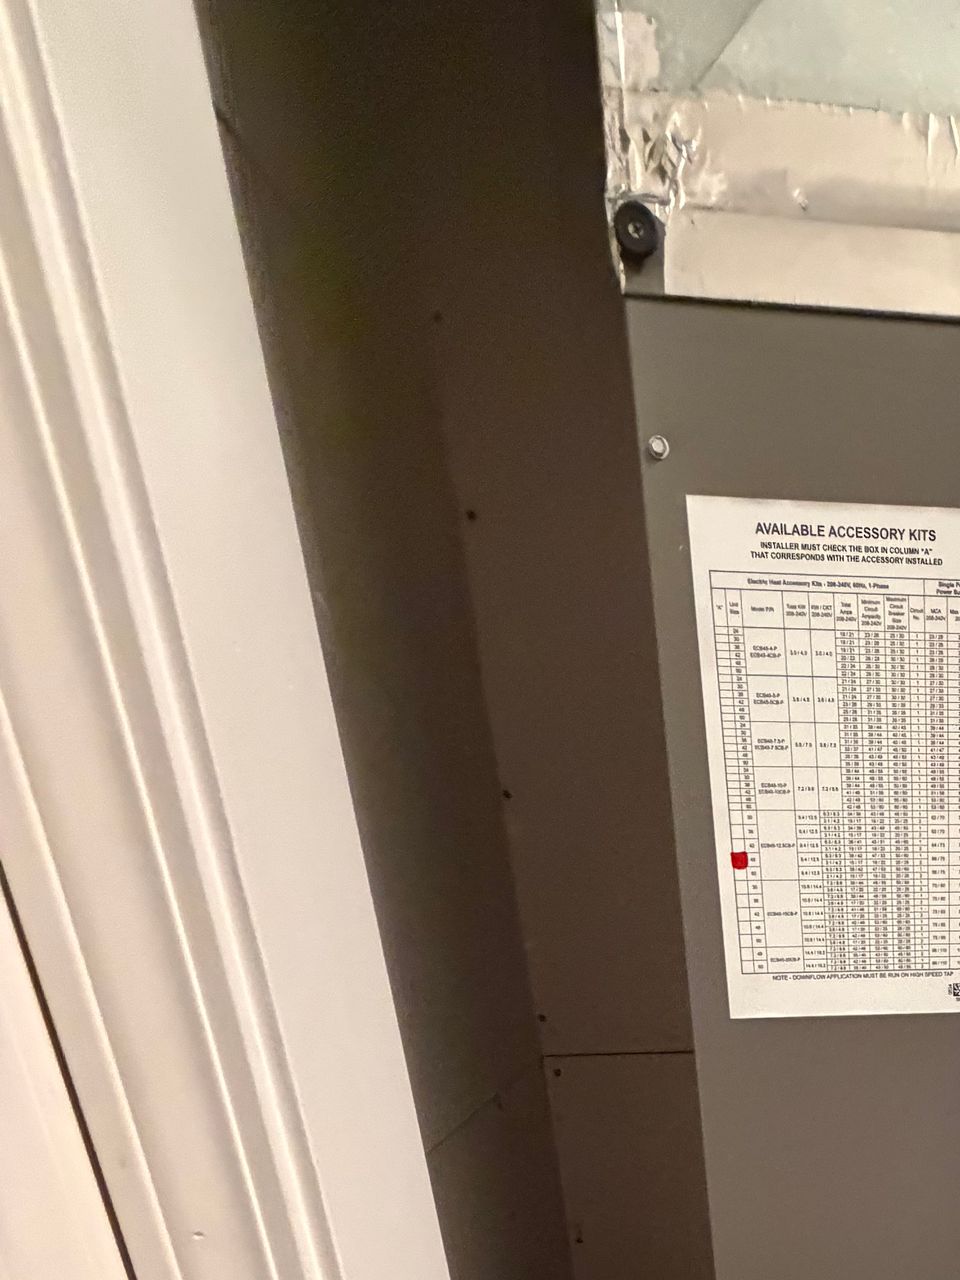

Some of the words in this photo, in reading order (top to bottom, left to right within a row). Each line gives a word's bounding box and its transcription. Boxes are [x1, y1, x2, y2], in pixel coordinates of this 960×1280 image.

[754, 521, 825, 536] AVAILABLE
[828, 525, 905, 540] ACCESSORY
[909, 528, 936, 541] KITS
[760, 541, 799, 550] INSTALLER
[822, 544, 846, 552] CHECK
[864, 545, 878, 553] BOX
[889, 546, 919, 555] COLUMN
[750, 550, 769, 559] THAT
[770, 551, 825, 561] CORRESPONDS
[861, 555, 903, 564] ACCESSORY
[905, 557, 942, 566] INSTALLED
